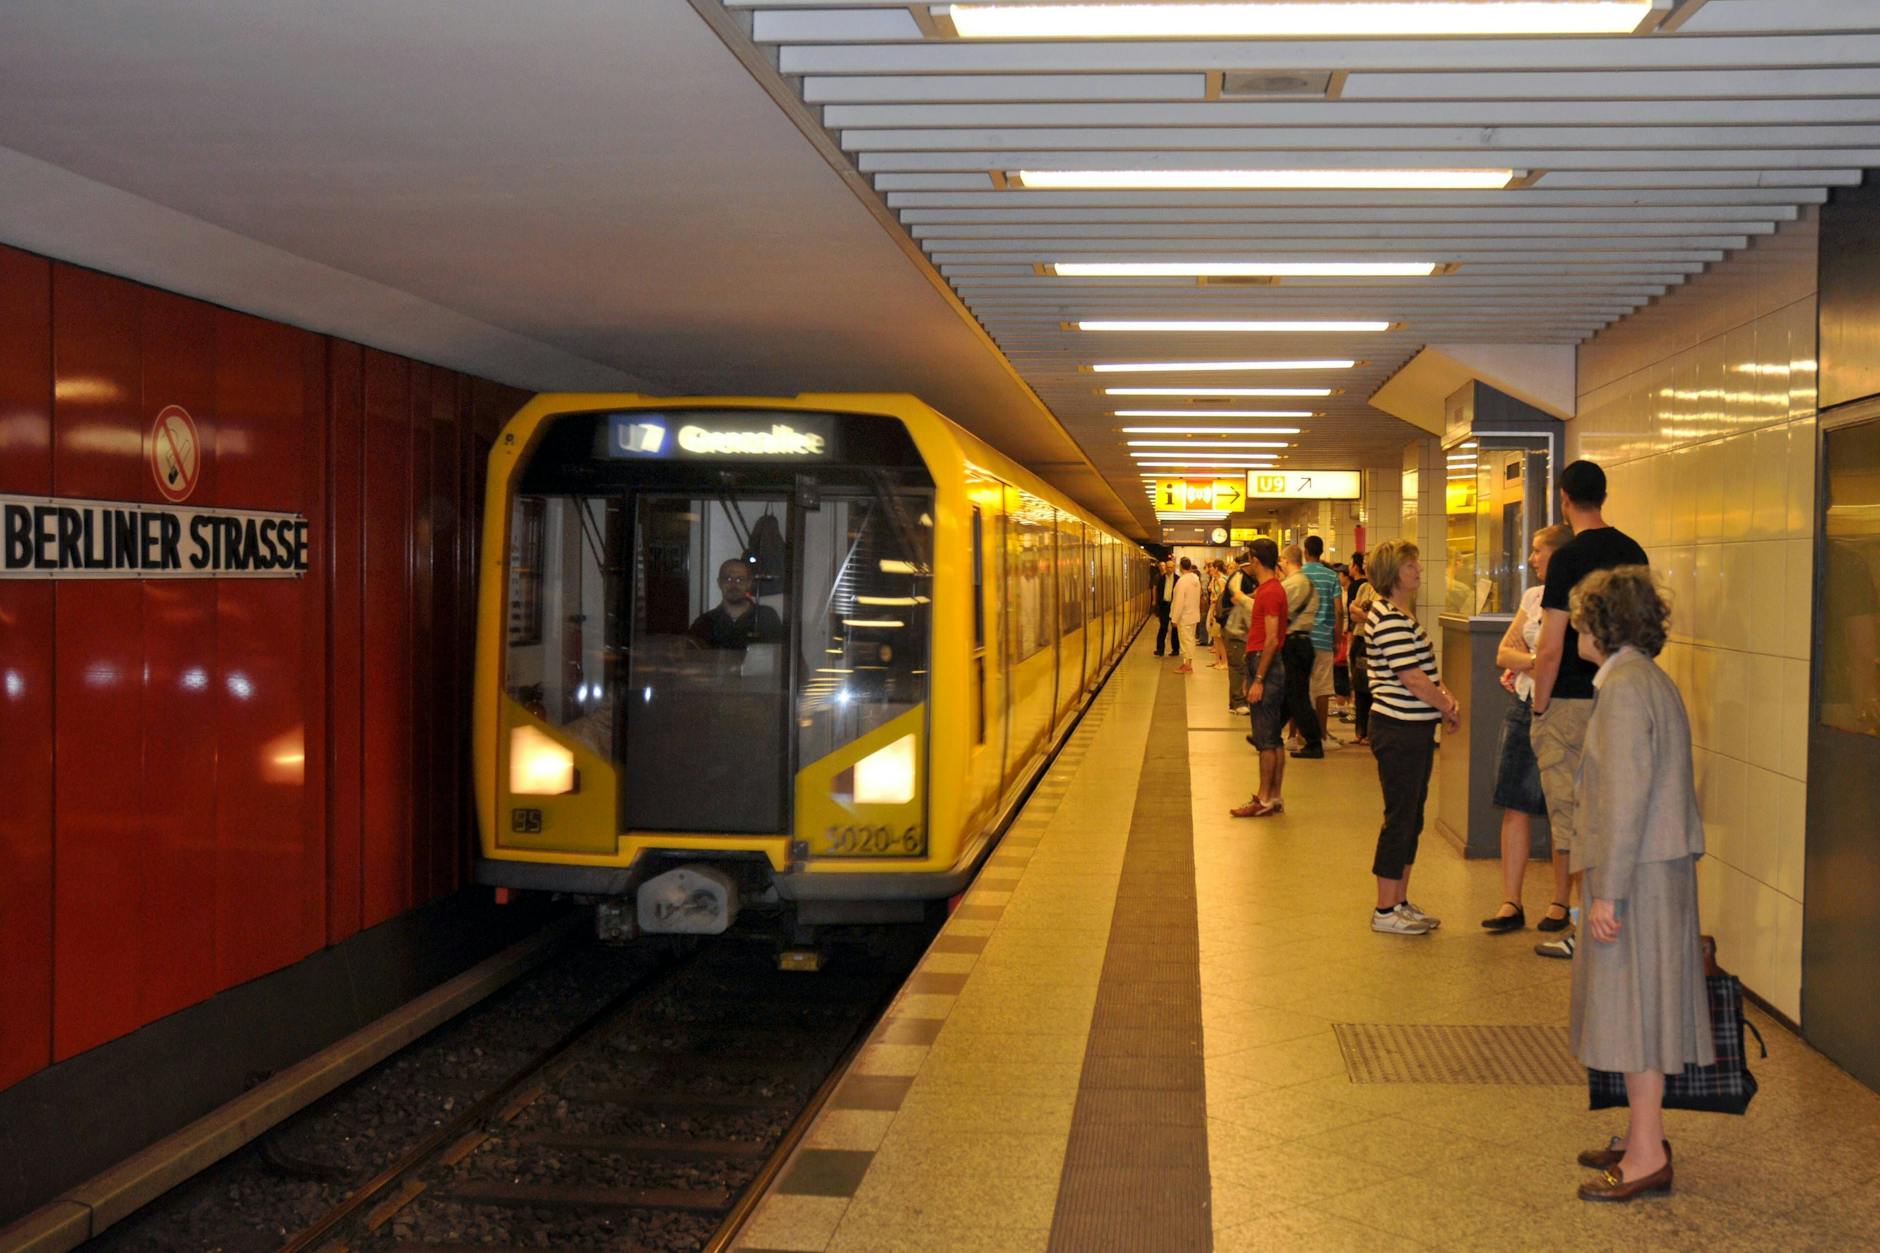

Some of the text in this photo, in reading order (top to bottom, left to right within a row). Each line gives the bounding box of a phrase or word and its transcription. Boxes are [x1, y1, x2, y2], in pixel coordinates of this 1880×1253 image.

[1260, 477, 1283, 491] U9
[5, 505, 308, 570] BERLINER STRASSE
